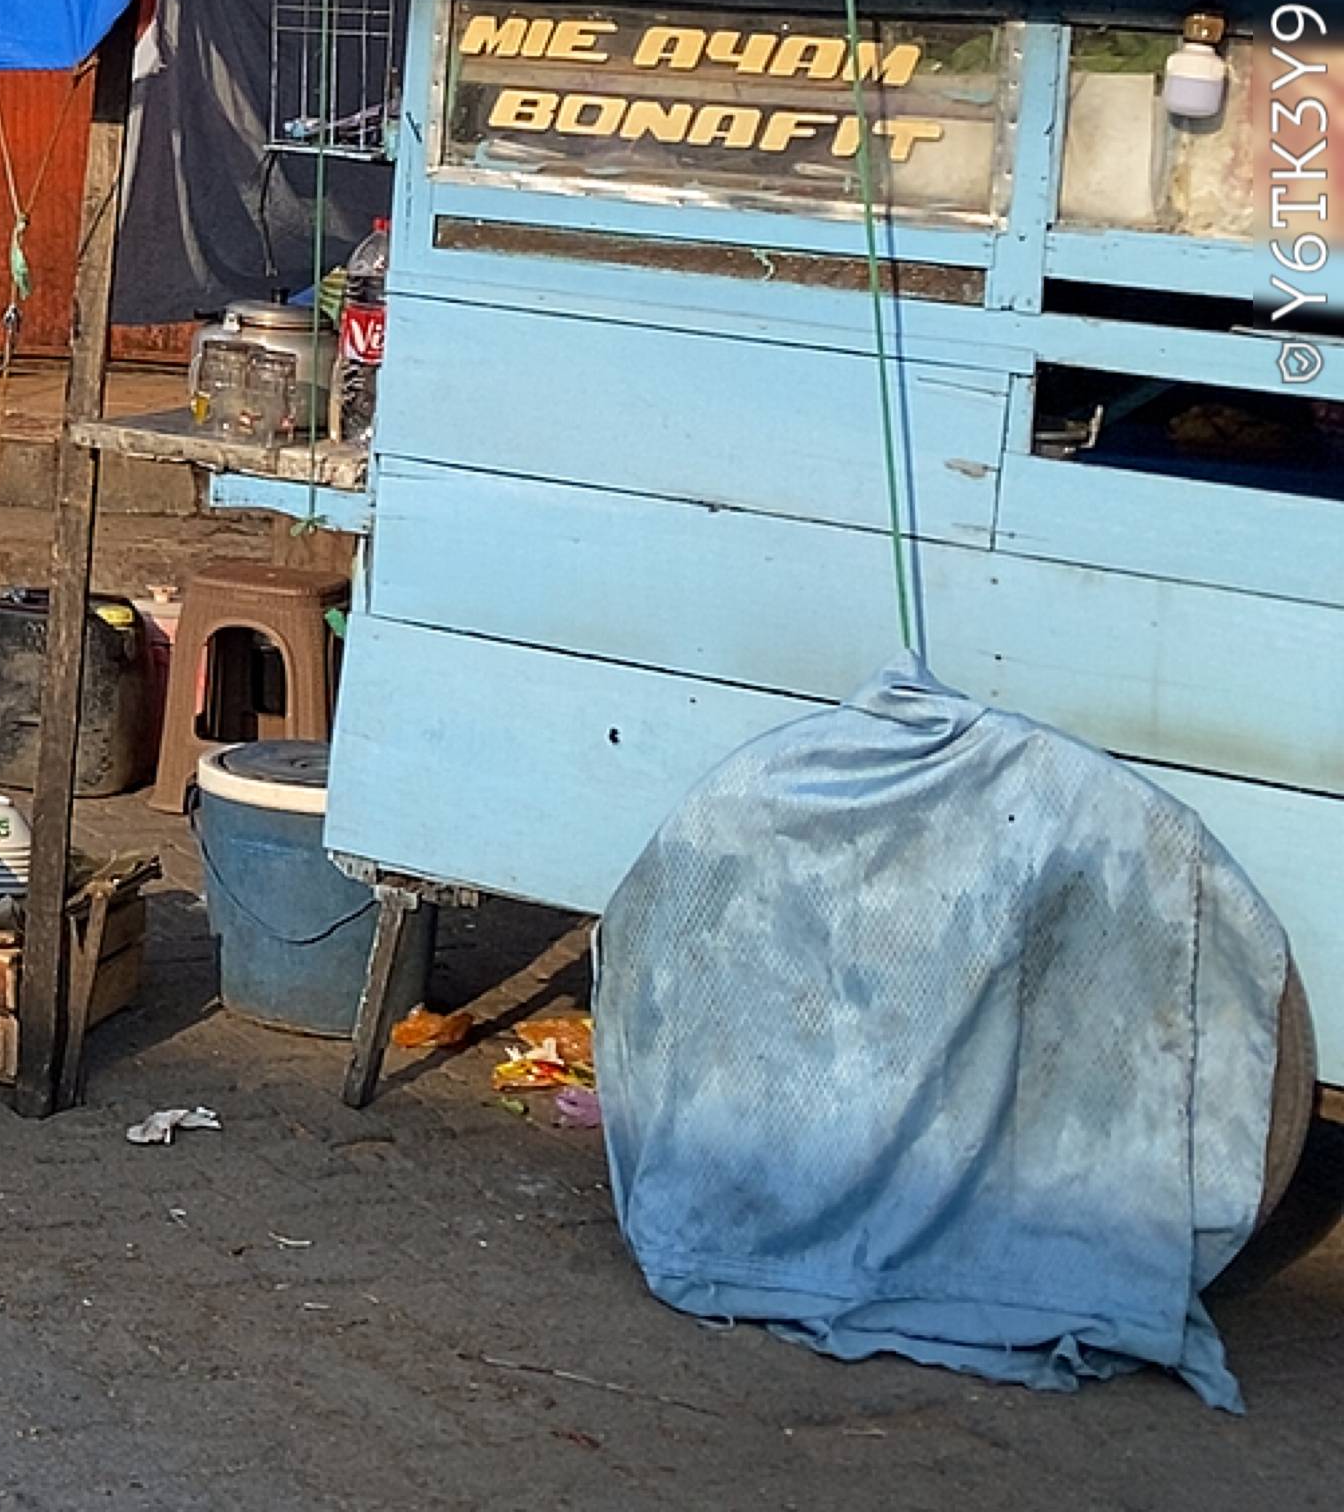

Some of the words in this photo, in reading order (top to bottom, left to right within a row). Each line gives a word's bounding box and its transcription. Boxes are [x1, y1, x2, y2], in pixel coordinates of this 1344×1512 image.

[458, 15, 618, 63] MIE
[632, 26, 922, 88] AYAM
[487, 89, 944, 164] BONAFIT
[350, 318, 384, 358] Vi
